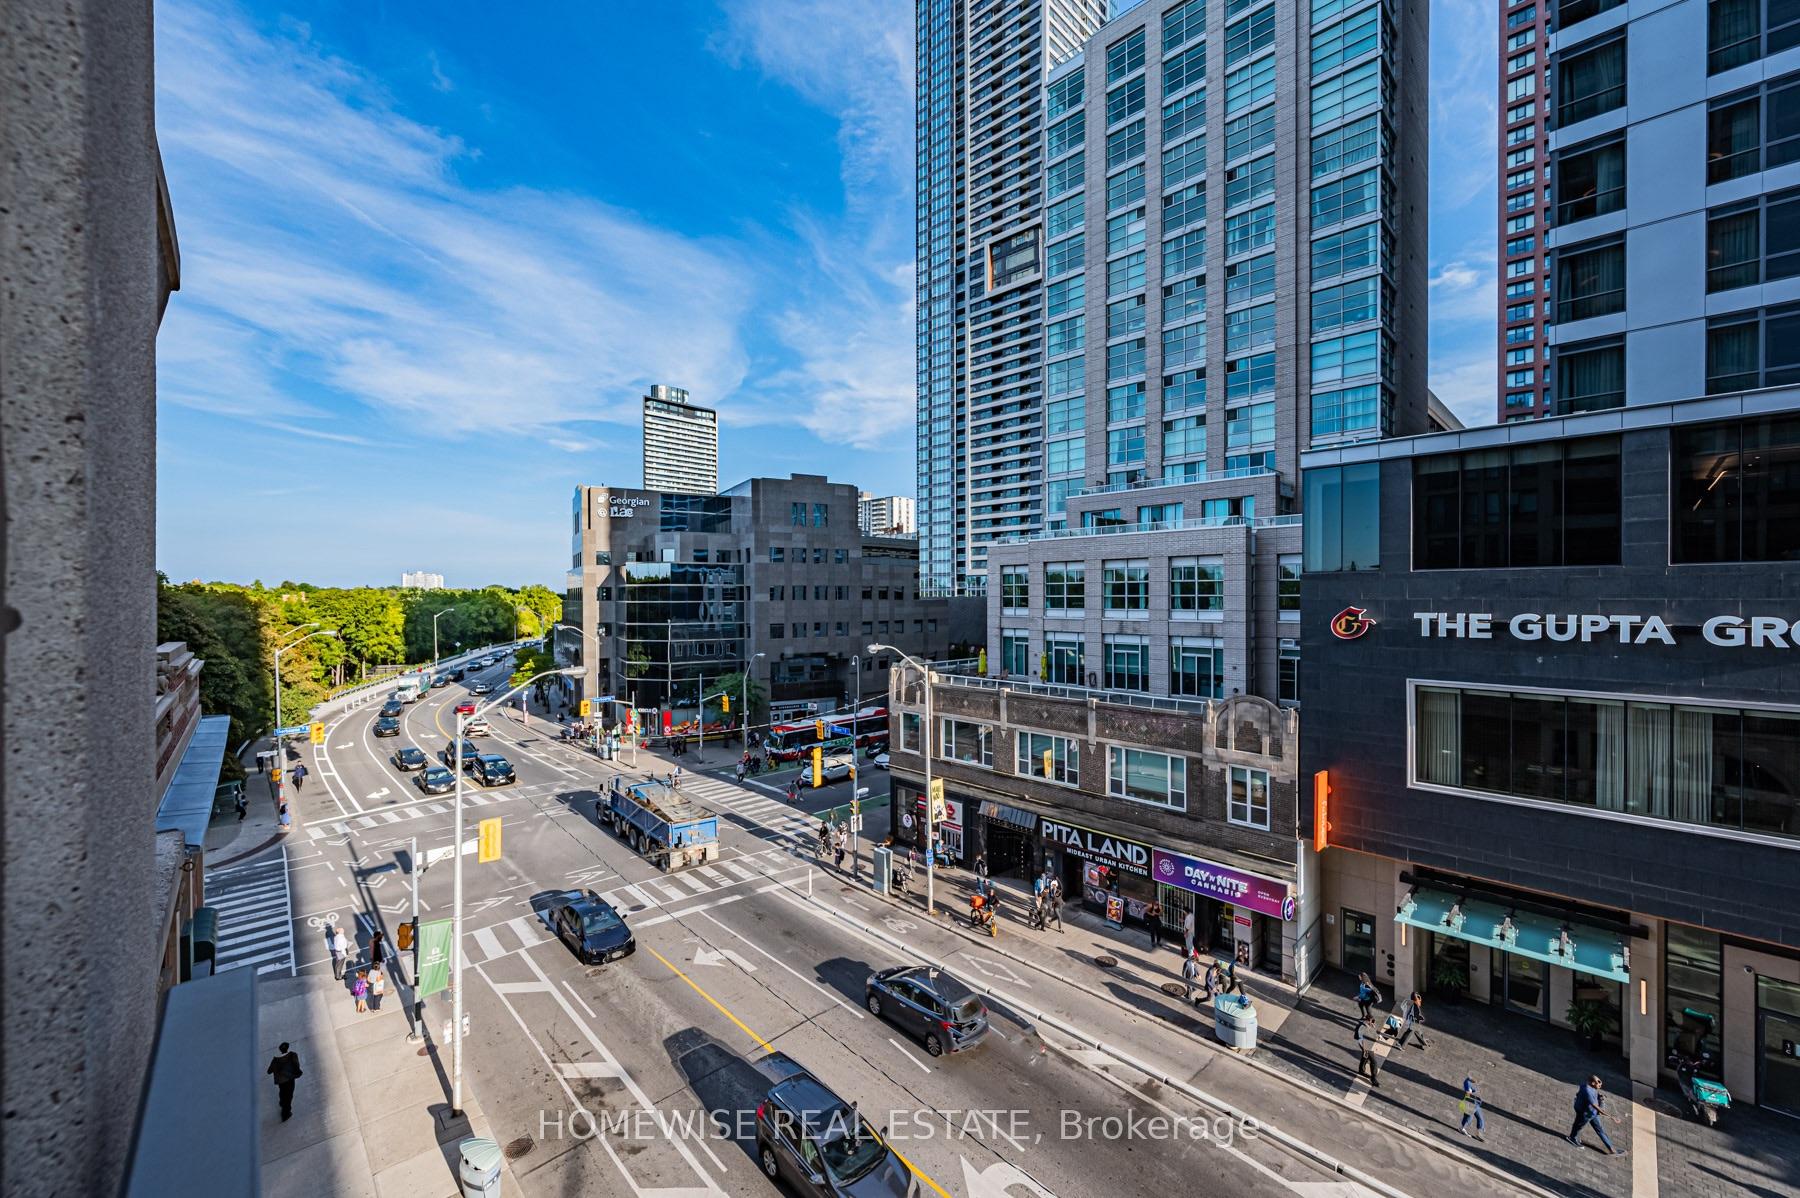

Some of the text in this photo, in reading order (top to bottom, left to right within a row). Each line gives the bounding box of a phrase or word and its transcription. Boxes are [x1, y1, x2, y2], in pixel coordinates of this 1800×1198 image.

[609, 495, 650, 508] Georgian
[1413, 612, 1800, 649] THE GUPTA GR
[1041, 820, 1149, 865] PITA LAND
[1066, 847, 1093, 860] MIDEAST
[1095, 856, 1117, 867] URBAN
[1118, 863, 1148, 877] KITCHEN
[1184, 866, 1209, 882] DAY
[1216, 874, 1249, 894] NITE
[1191, 879, 1242, 898] CANNABIS
